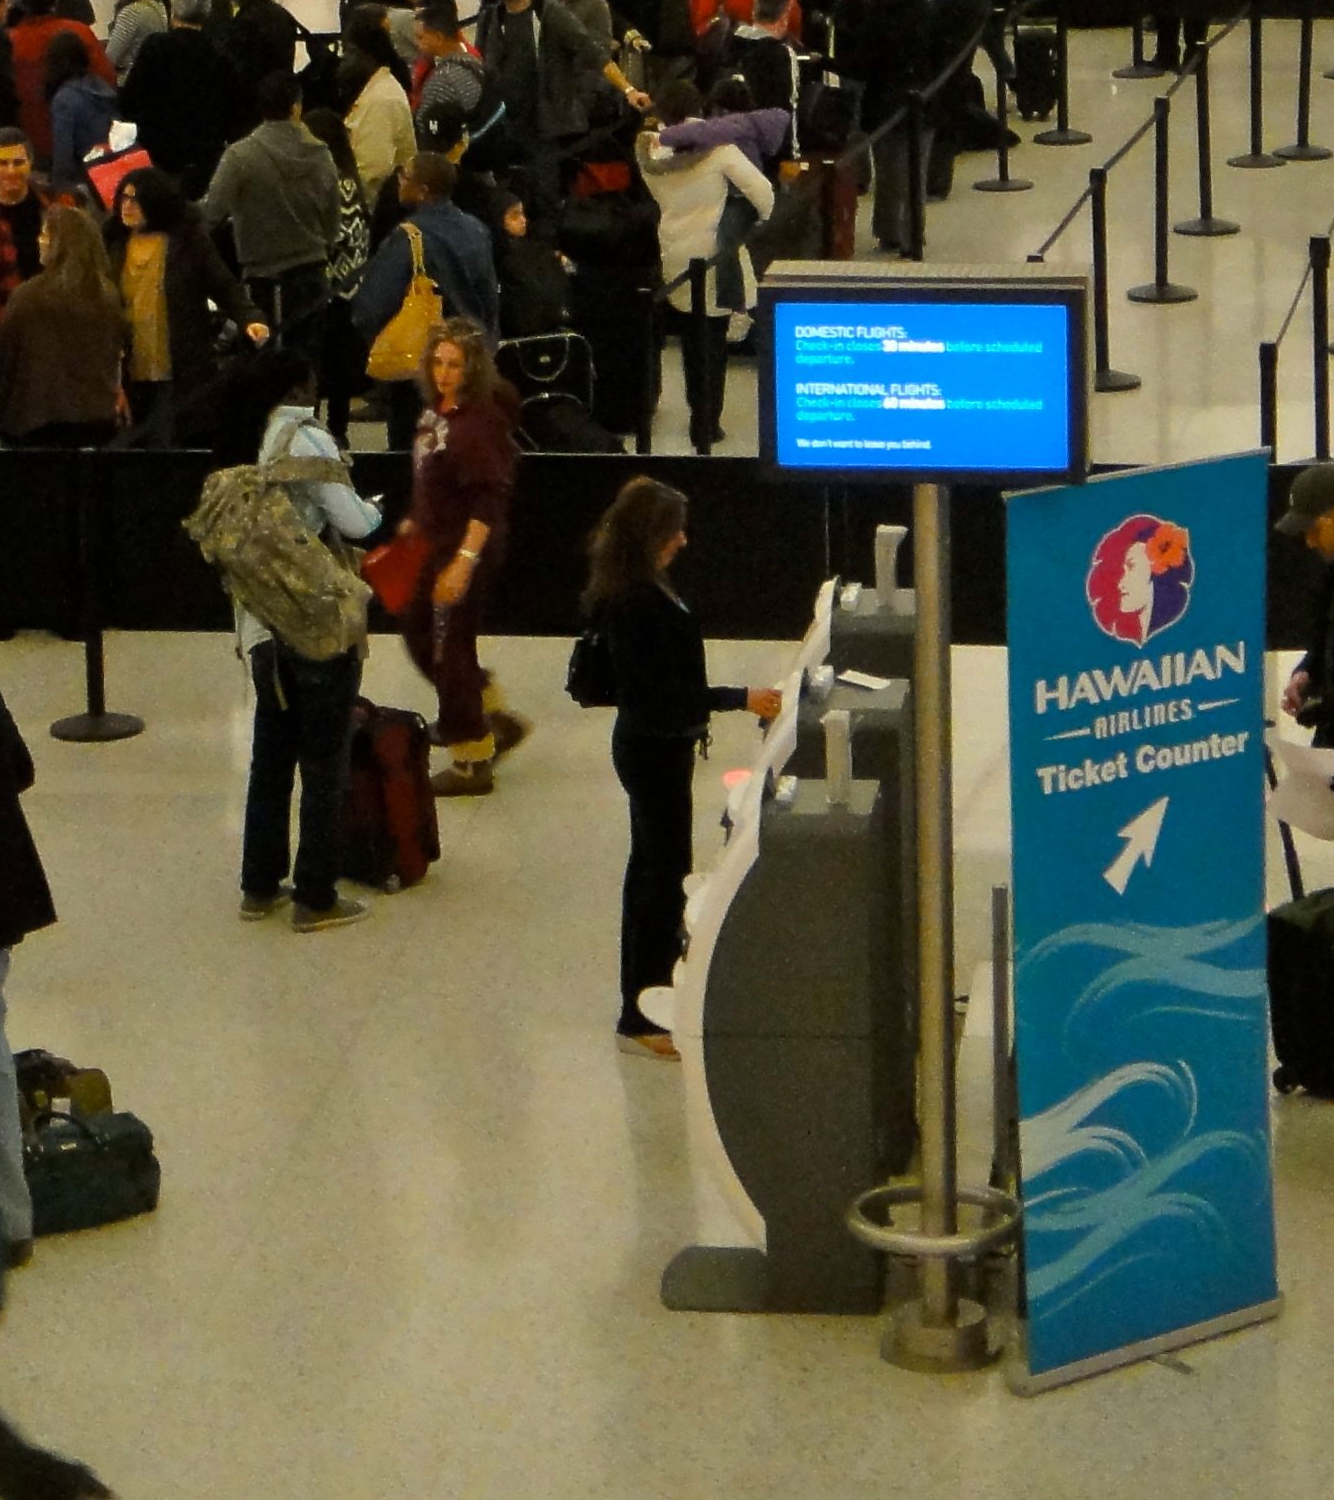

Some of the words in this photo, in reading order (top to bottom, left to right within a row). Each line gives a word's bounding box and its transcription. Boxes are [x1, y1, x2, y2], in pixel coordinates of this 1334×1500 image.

[795, 326, 854, 338] DOMESTIC
[856, 326, 907, 339] FLIGHTS:
[796, 341, 843, 351] Check-in
[847, 341, 881, 351] closes
[898, 341, 945, 352] minutes
[946, 341, 982, 352] before
[986, 341, 1043, 353] scheduled
[795, 383, 888, 395] INTERNATIONAL
[890, 384, 942, 396] FLIGHTS:
[796, 398, 843, 408] Check-in
[847, 399, 881, 409] closes
[898, 398, 945, 410] minutes
[947, 399, 983, 410] before
[986, 399, 1043, 410] scheduled
[1035, 641, 1246, 714] HAWAIIAN
[1094, 699, 1193, 739] AIRLINES
[1036, 752, 1128, 794] Ticket
[1135, 731, 1250, 773] Counter
